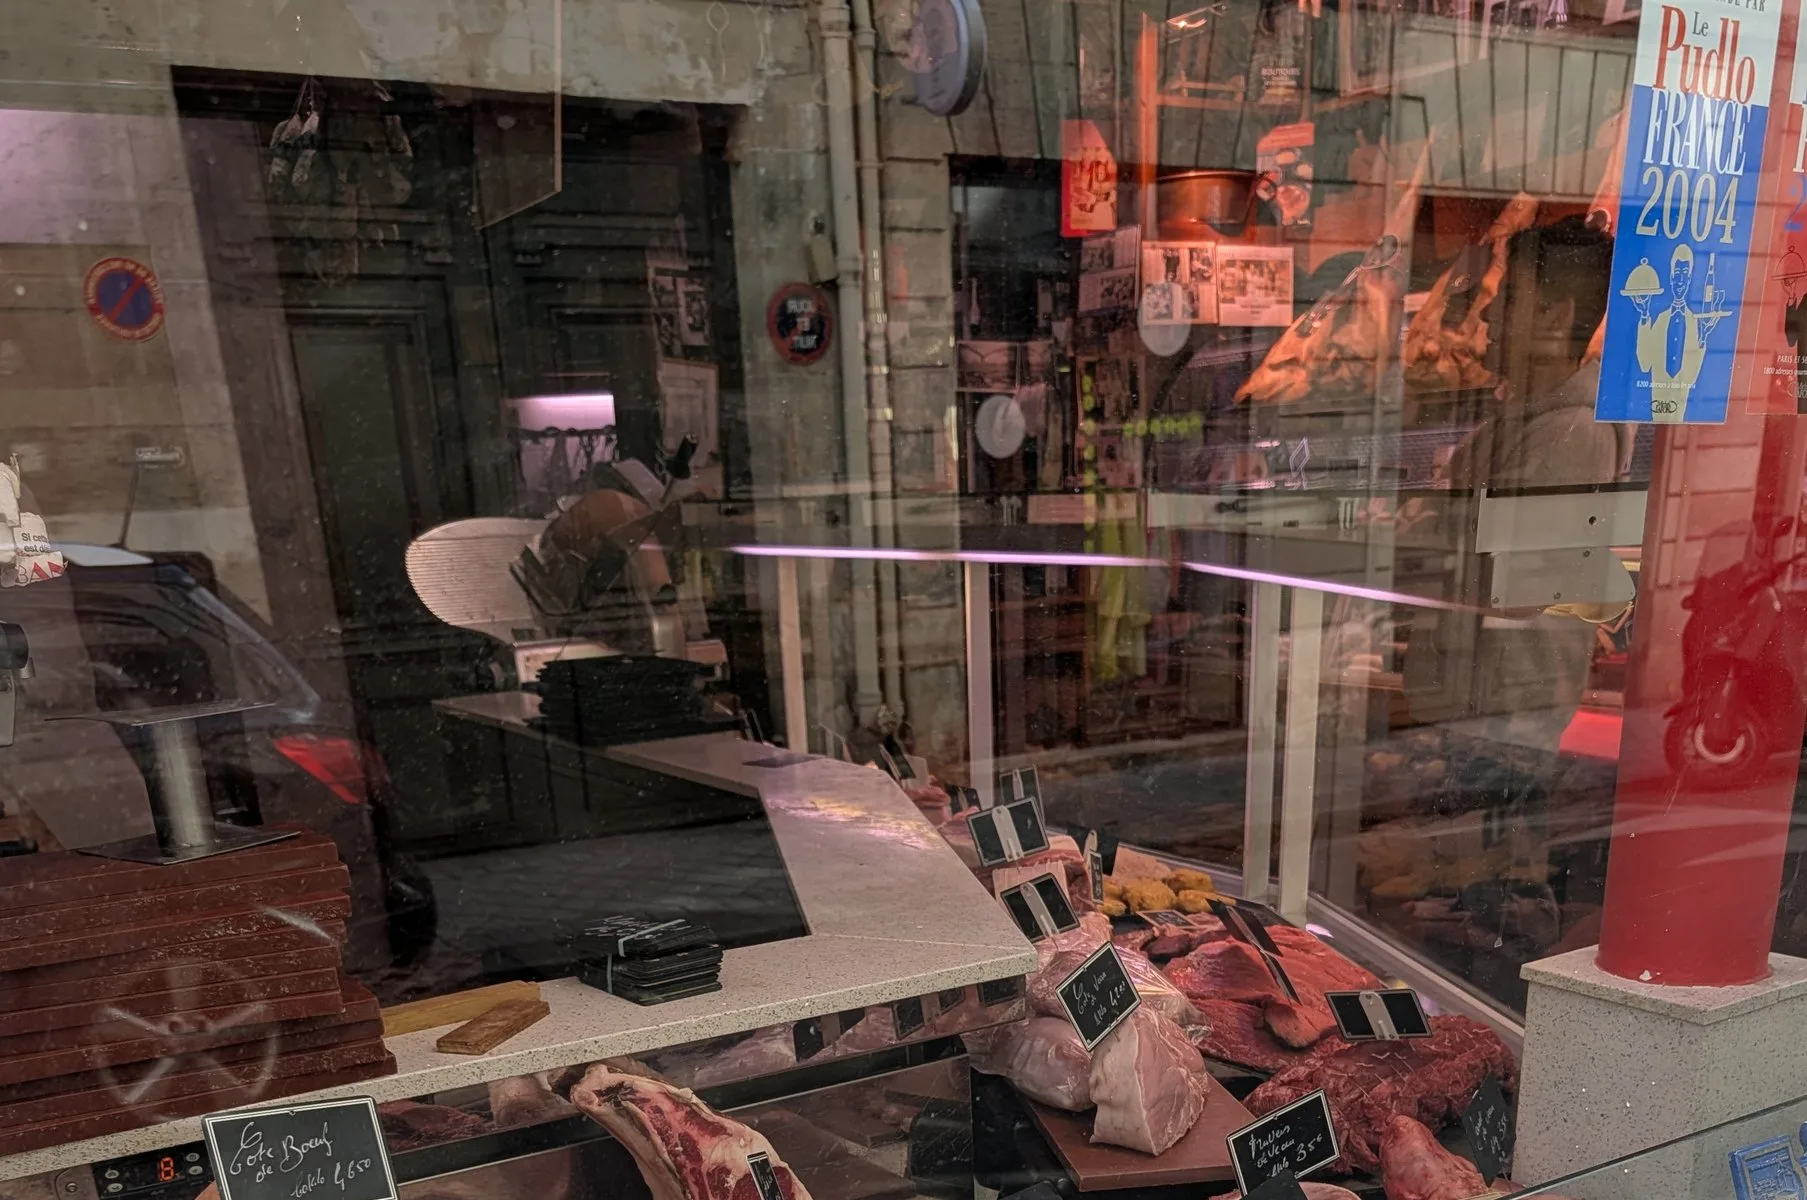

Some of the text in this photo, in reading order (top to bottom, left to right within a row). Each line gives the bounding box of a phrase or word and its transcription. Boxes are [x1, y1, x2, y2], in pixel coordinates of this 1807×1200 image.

[1652, 5, 1755, 104] Pudlo
[1692, 11, 1709, 37] Le
[1643, 88, 1750, 176] FRANCE
[1635, 167, 1738, 244] 2004
[160, 1157, 174, 1181] 8
